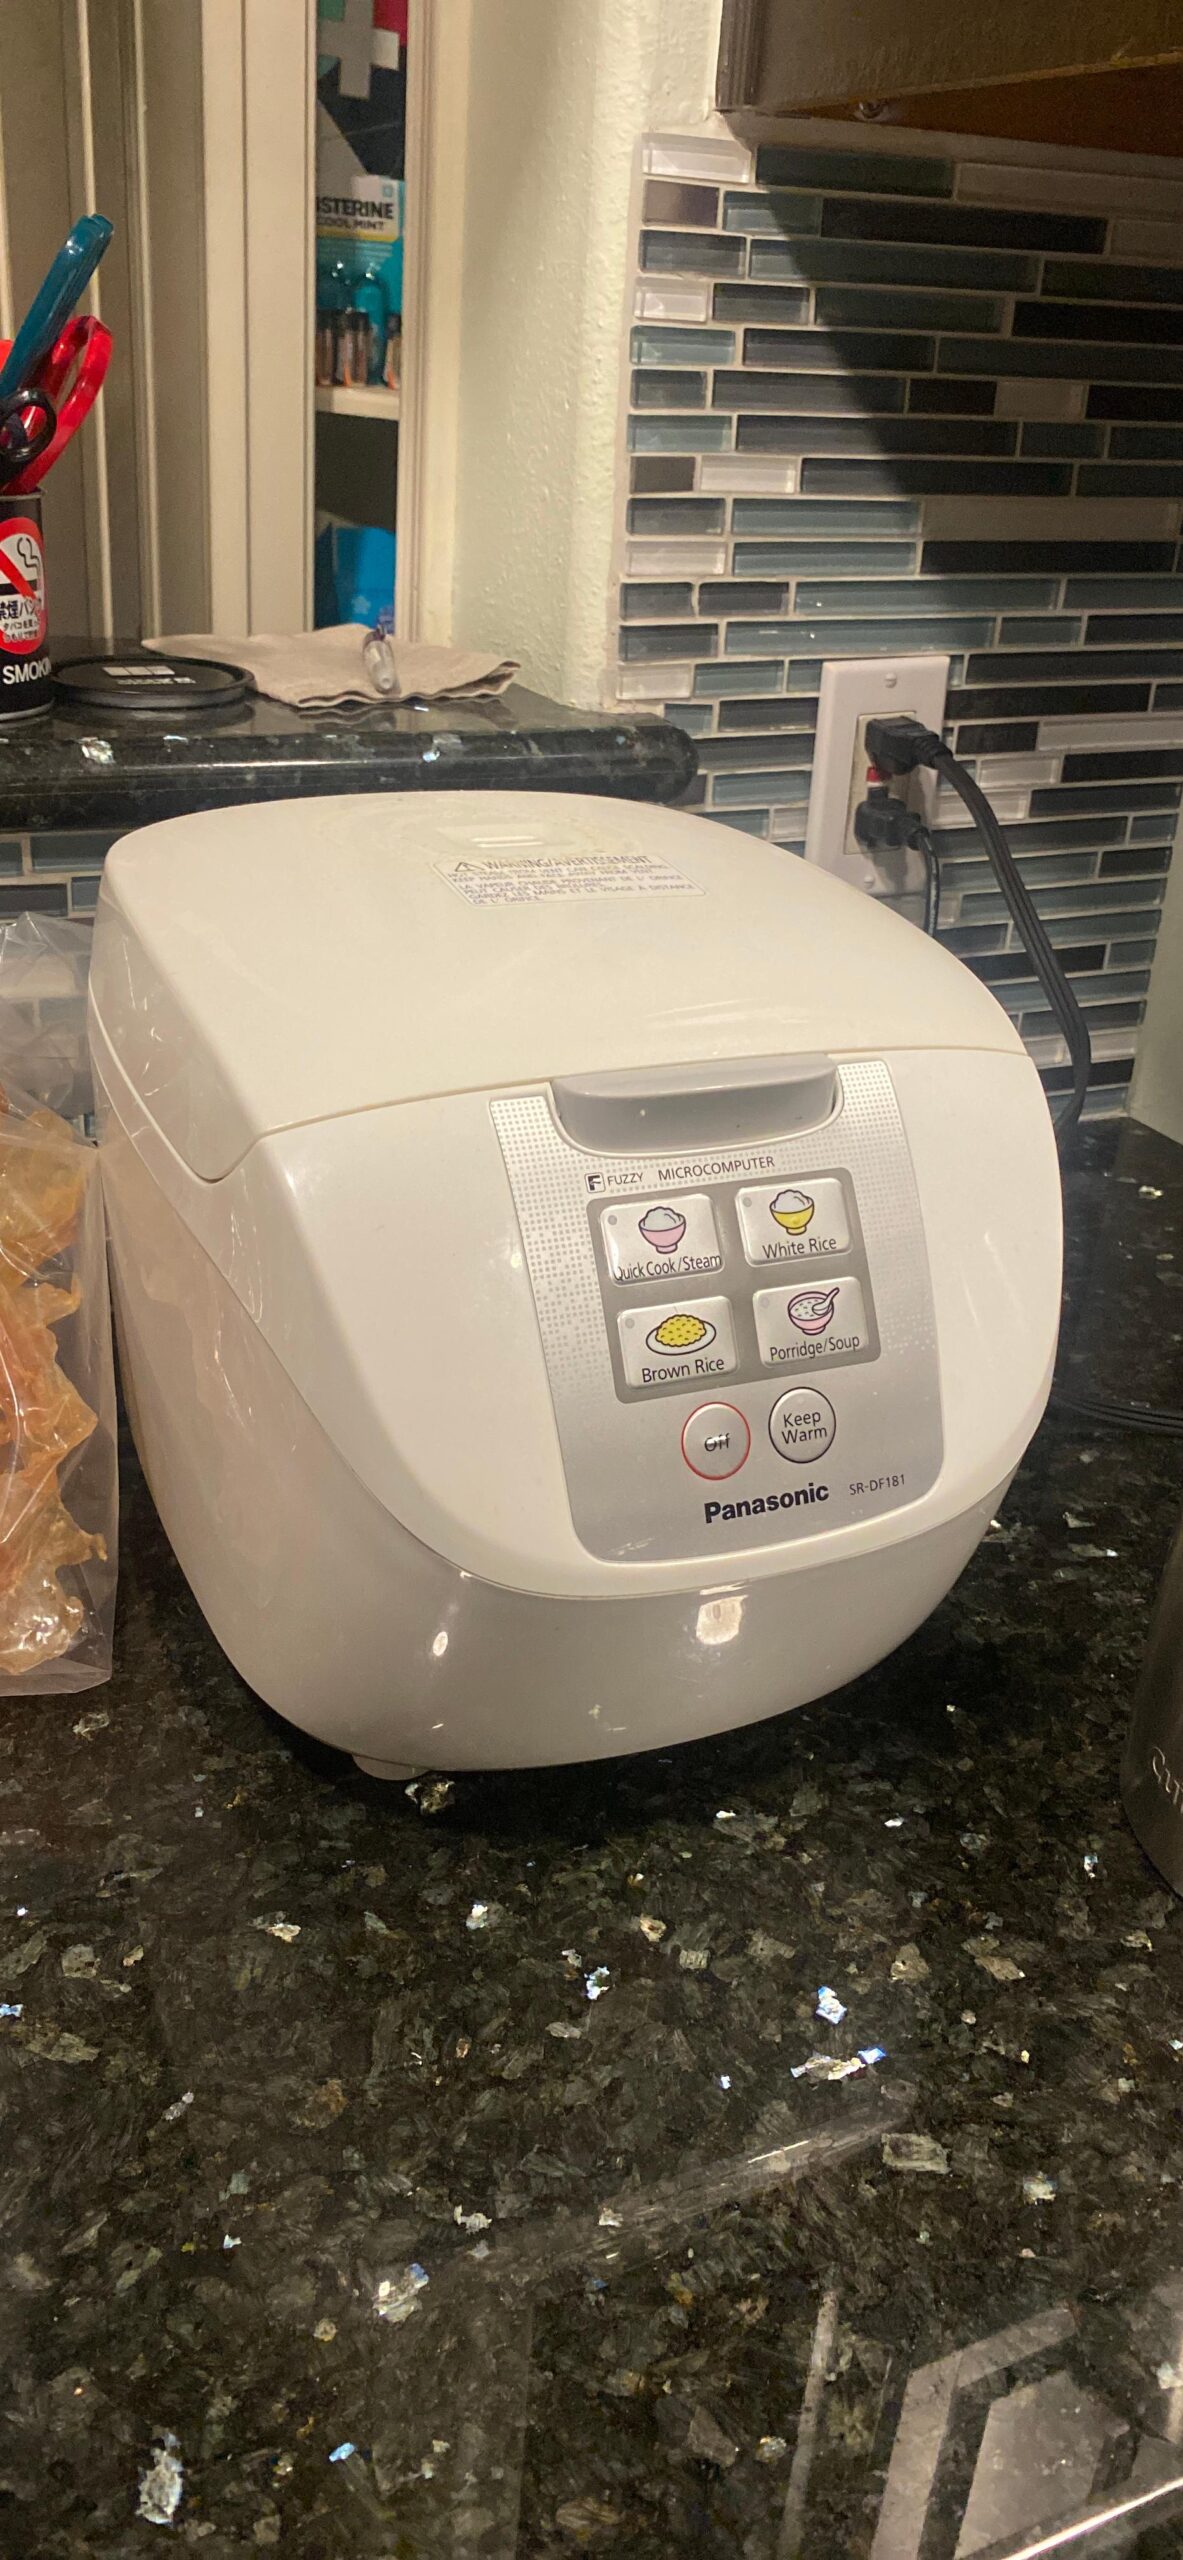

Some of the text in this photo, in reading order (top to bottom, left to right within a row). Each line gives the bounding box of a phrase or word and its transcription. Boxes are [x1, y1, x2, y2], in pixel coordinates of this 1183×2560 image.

[315, 196, 394, 219] ISTERINE
[607, 1172, 644, 1186] FUZZY
[658, 1156, 775, 1181] MICROCOMPUTER
[762, 1236, 837, 1259] White Rice
[614, 1262, 645, 1281] Quick
[769, 1334, 860, 1361] Porridge/Soup
[641, 1356, 725, 1383] Brown Rice
[783, 1411, 821, 1428] Keep
[704, 1432, 731, 1452] Off
[782, 1425, 828, 1445] Warm
[849, 1474, 906, 1496] SR-DF181
[704, 1482, 829, 1524] Panasonic
